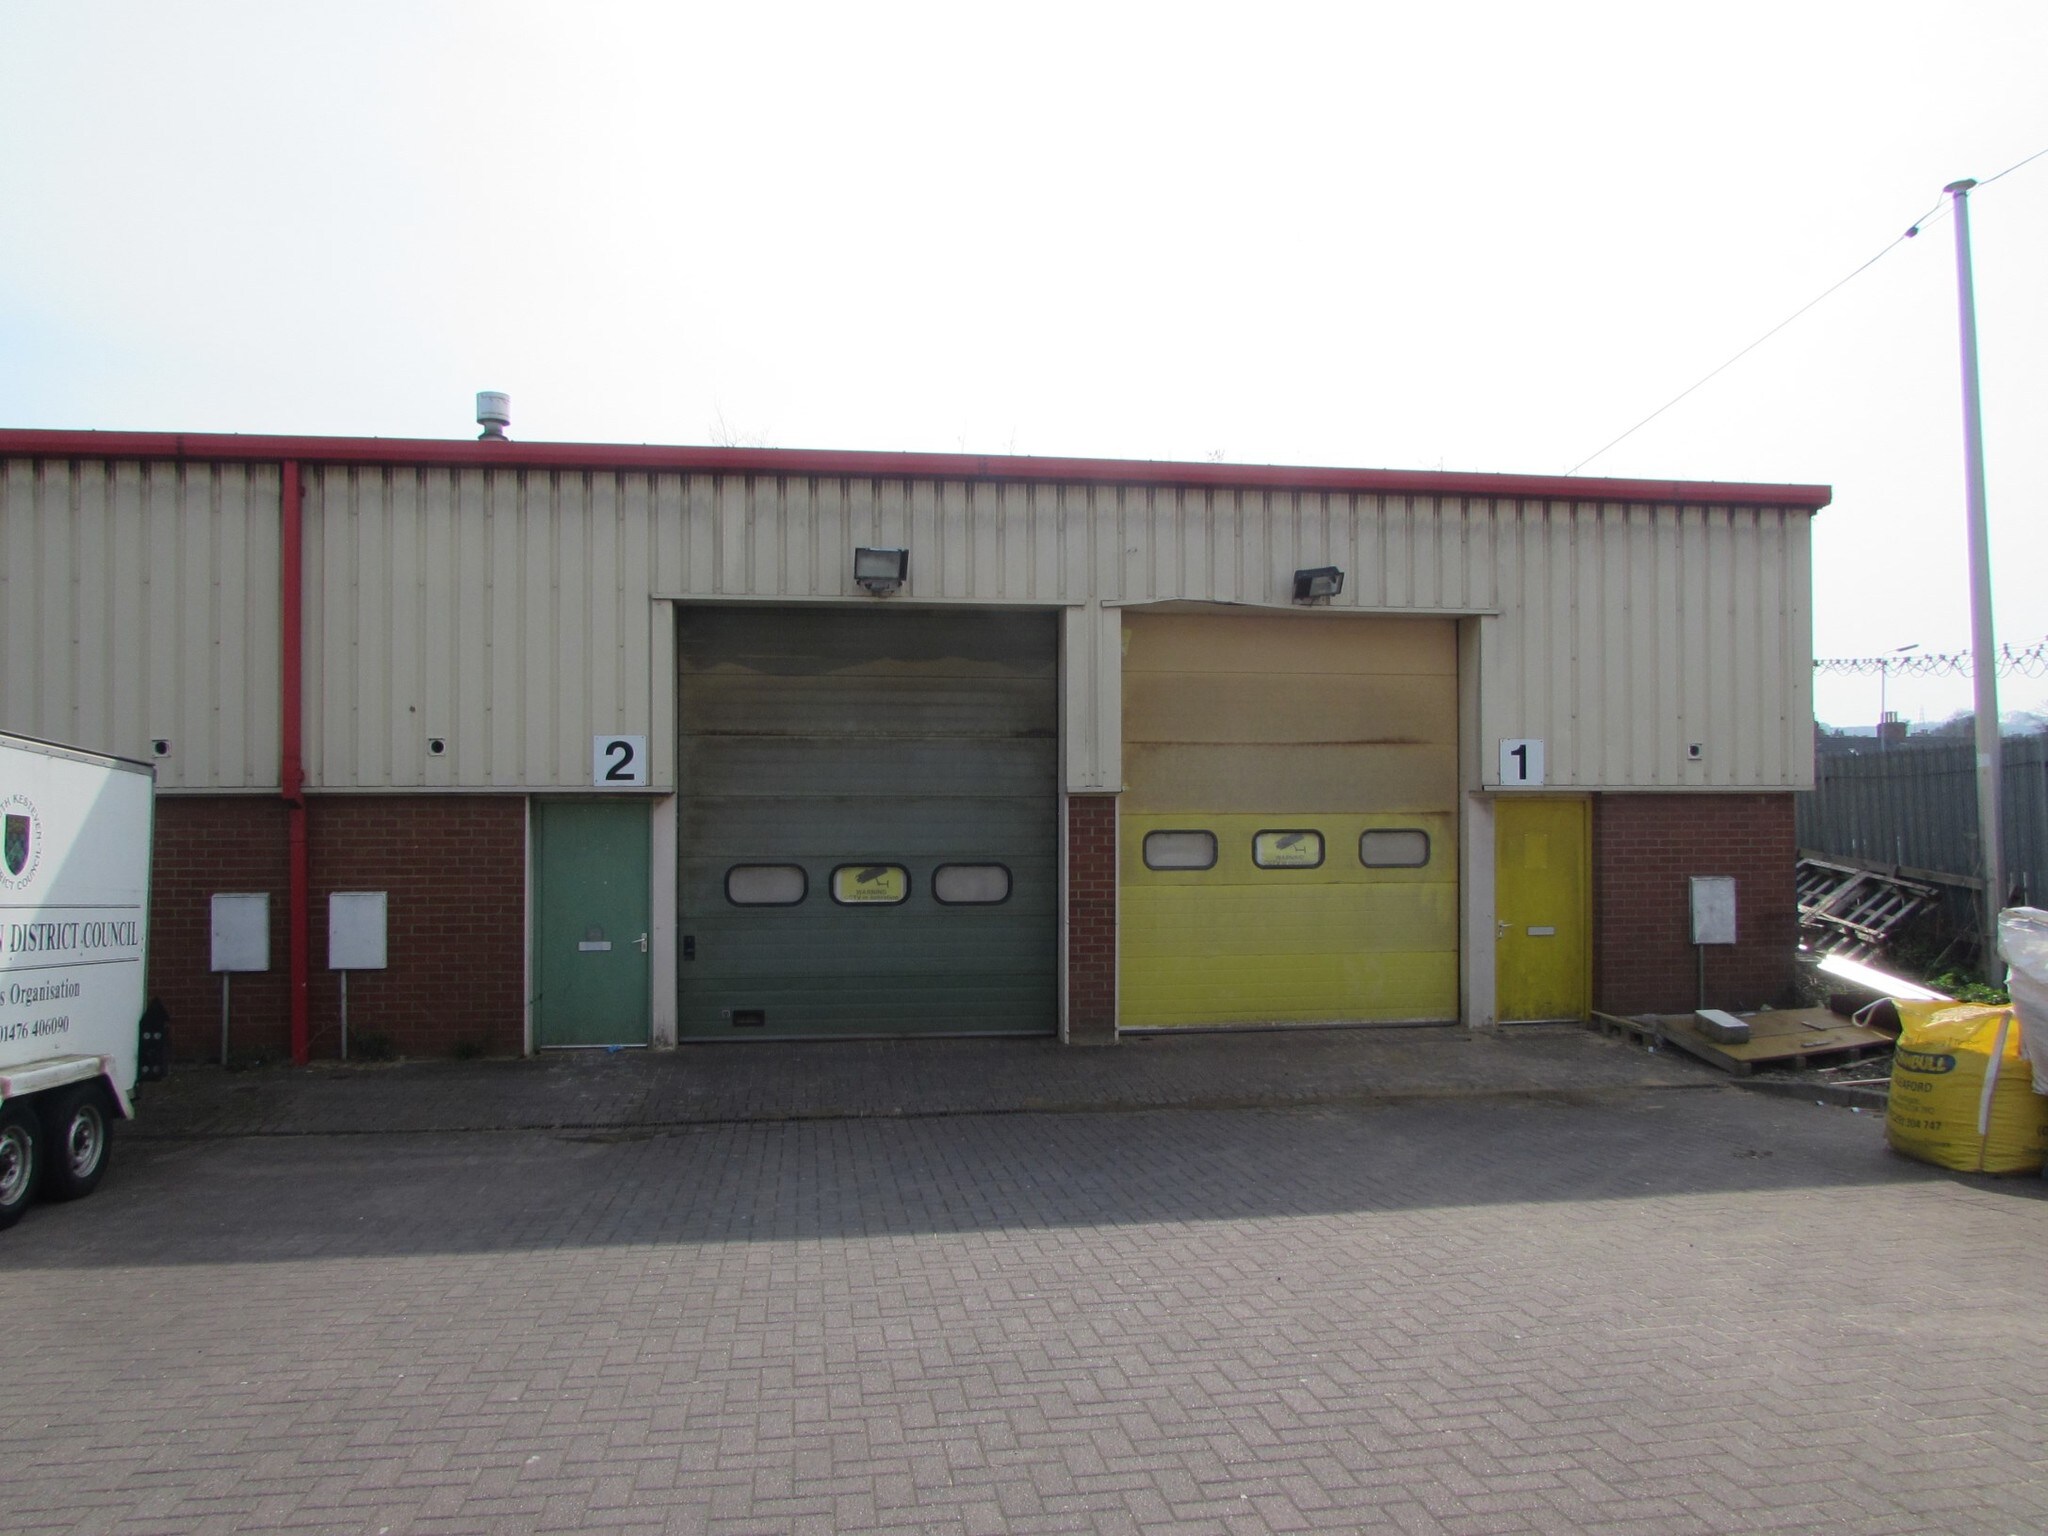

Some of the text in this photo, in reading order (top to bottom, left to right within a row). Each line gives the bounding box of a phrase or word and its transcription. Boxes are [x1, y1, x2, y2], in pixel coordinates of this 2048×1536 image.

[605, 740, 635, 781] 2
[1510, 744, 1527, 780] 1
[10, 923, 79, 952] DISTRICT
[83, 921, 138, 948] COUNCIL
[11, 978, 80, 1007] Organisation
[32, 1016, 69, 1037] 406090
